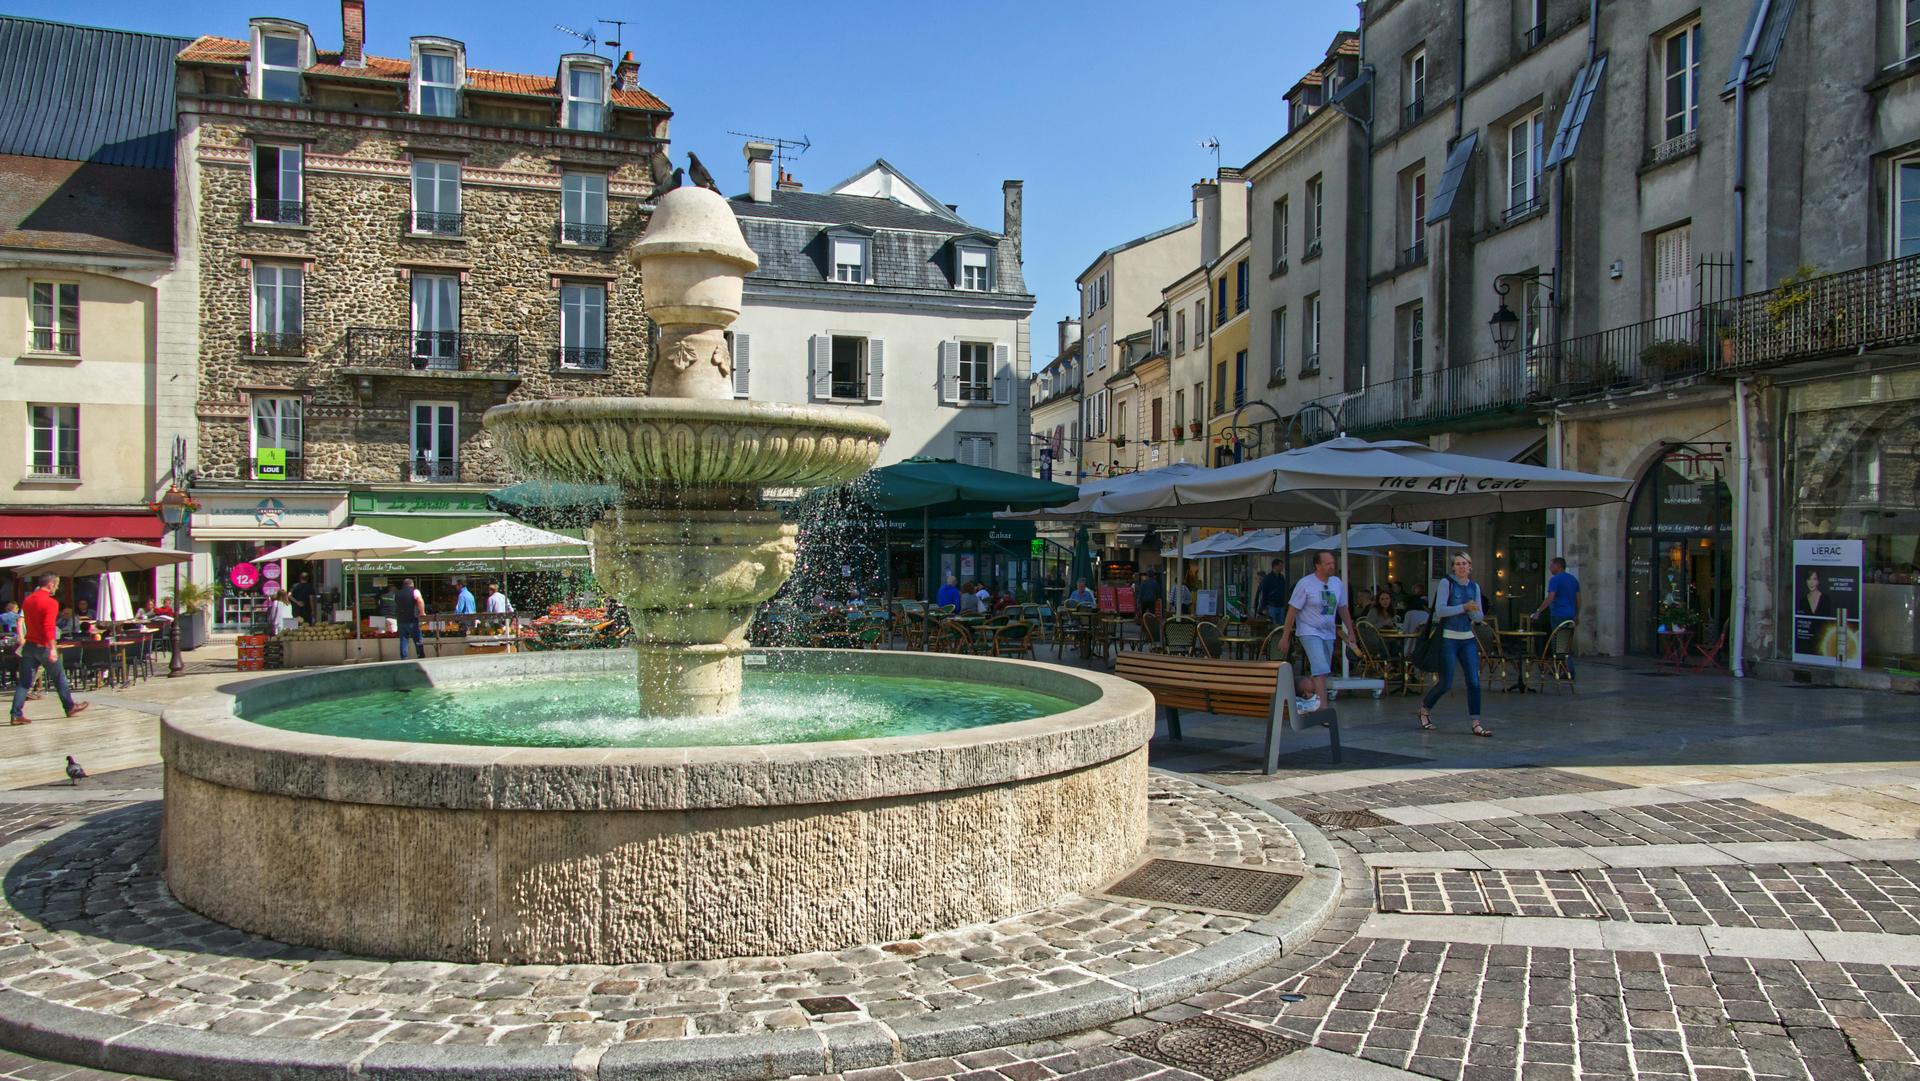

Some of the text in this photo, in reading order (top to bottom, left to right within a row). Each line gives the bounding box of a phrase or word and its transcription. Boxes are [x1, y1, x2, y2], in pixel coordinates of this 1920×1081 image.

[1379, 476, 1418, 489] The
[1427, 476, 1468, 491] Art
[4, 539, 13, 549] LE
[16, 539, 40, 549] SAINT
[1811, 547, 1841, 555] LIERAC
[345, 561, 375, 571] Coeilles
